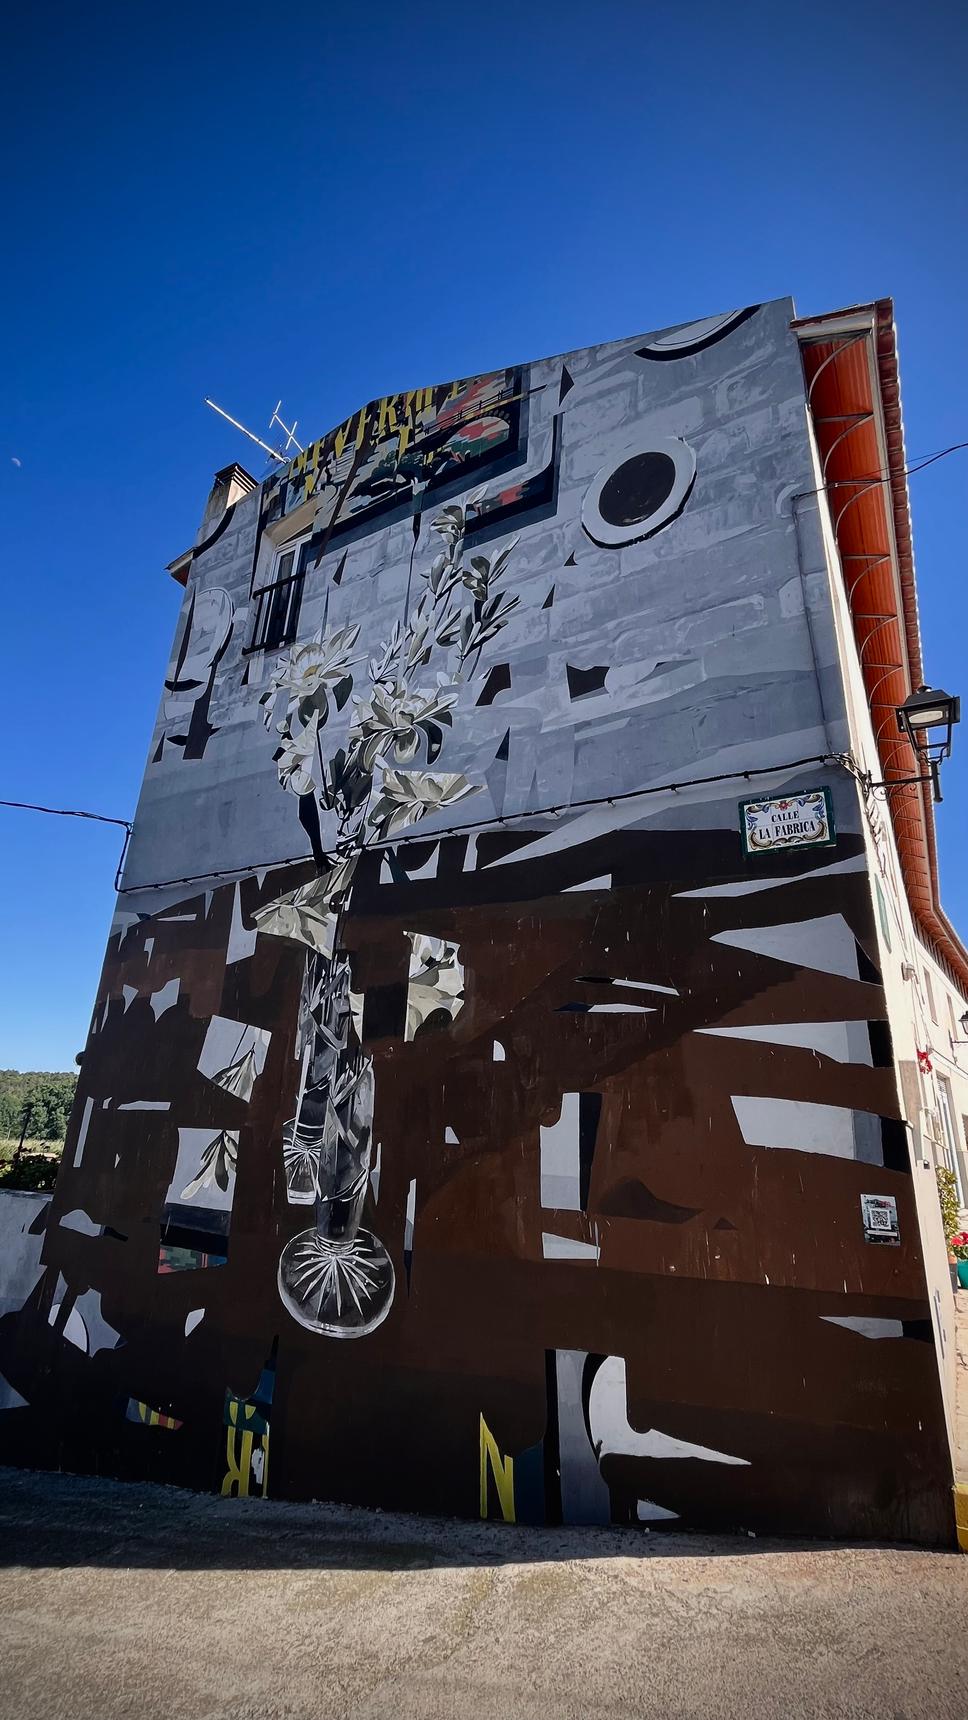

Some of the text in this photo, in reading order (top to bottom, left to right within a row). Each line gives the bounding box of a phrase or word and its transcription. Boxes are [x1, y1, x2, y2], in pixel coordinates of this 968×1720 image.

[771, 810, 800, 823] CALLE
[759, 820, 816, 840] LA FABRICA
